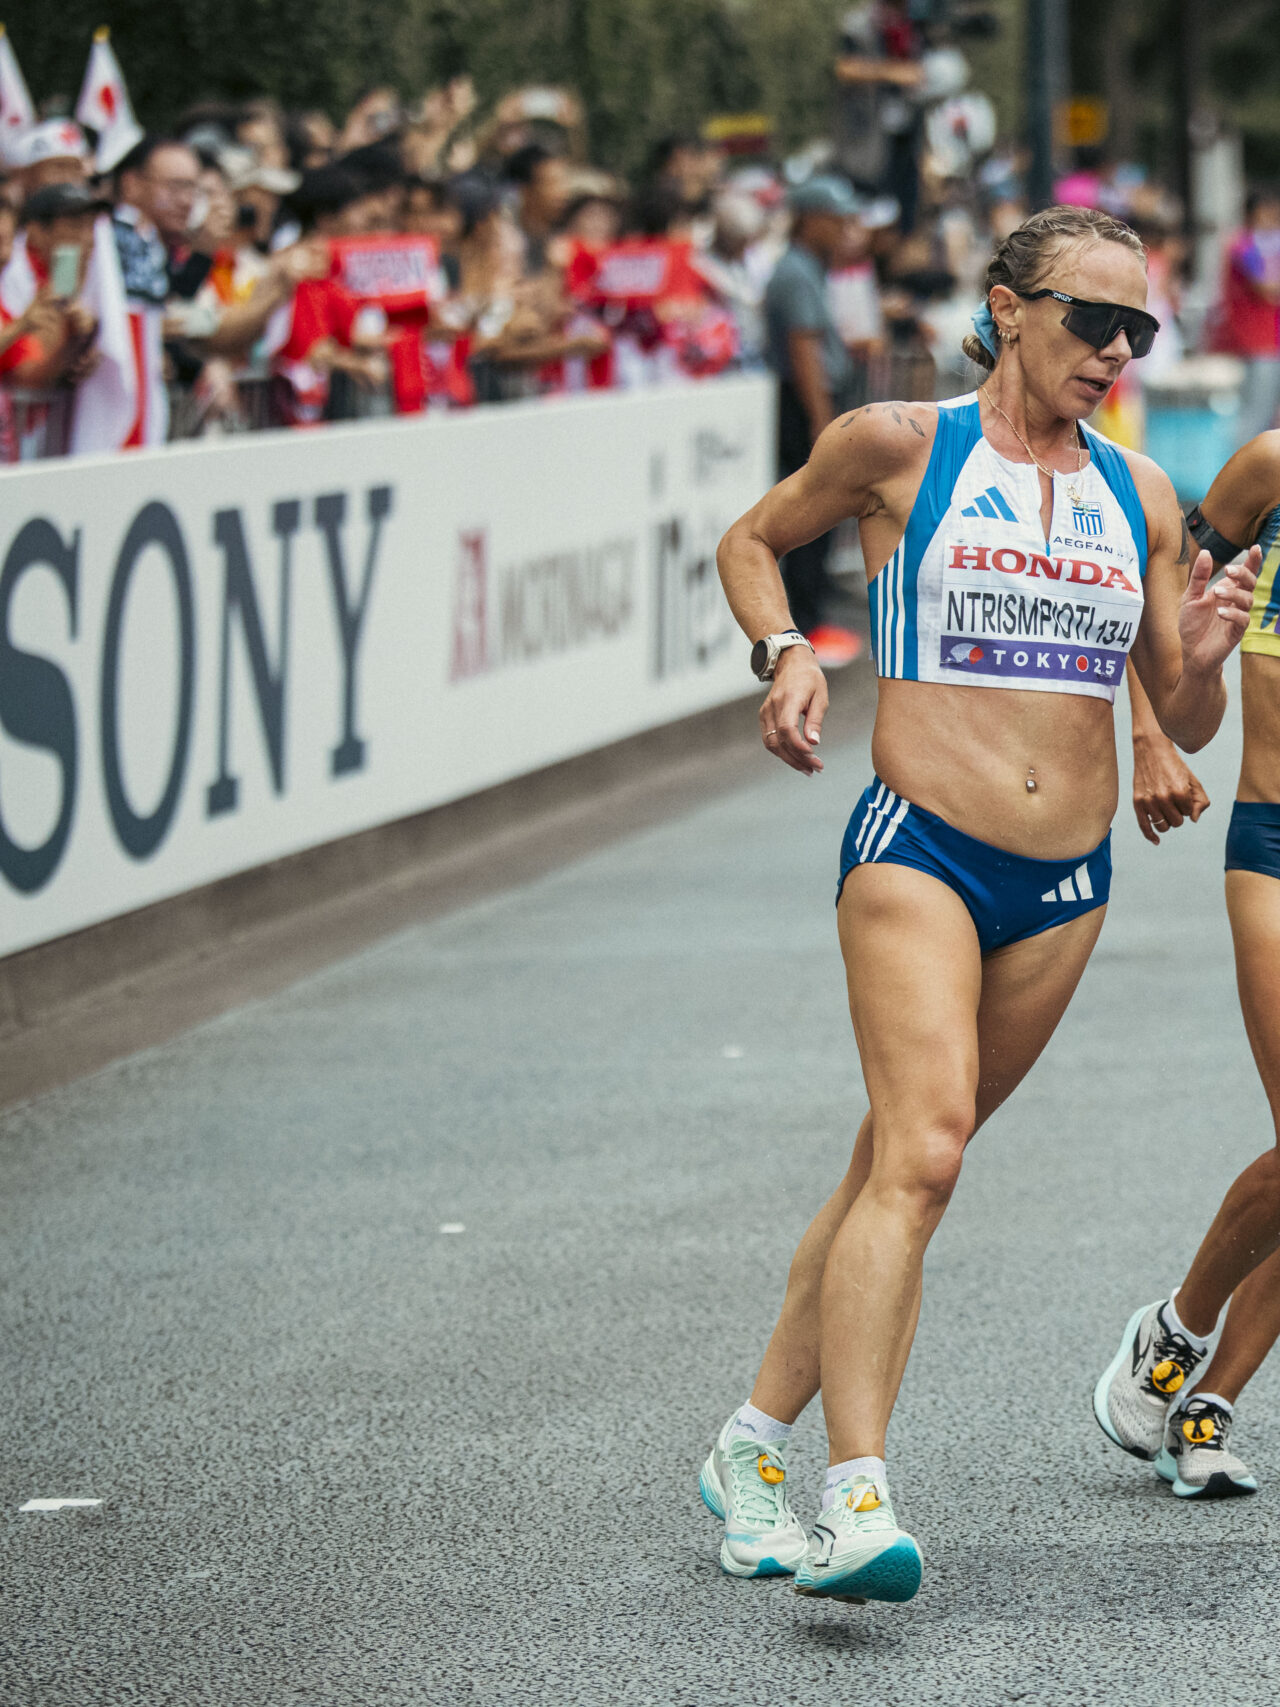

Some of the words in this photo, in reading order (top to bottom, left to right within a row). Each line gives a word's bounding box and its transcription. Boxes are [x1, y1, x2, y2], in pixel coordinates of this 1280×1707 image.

[949, 546, 1138, 593] HONDA
[1053, 536, 1113, 554] AEGEAN
[947, 590, 1096, 642] NTRISMPIOTI
[1096, 619, 1133, 647] 134
[0, 485, 392, 898] SONY
